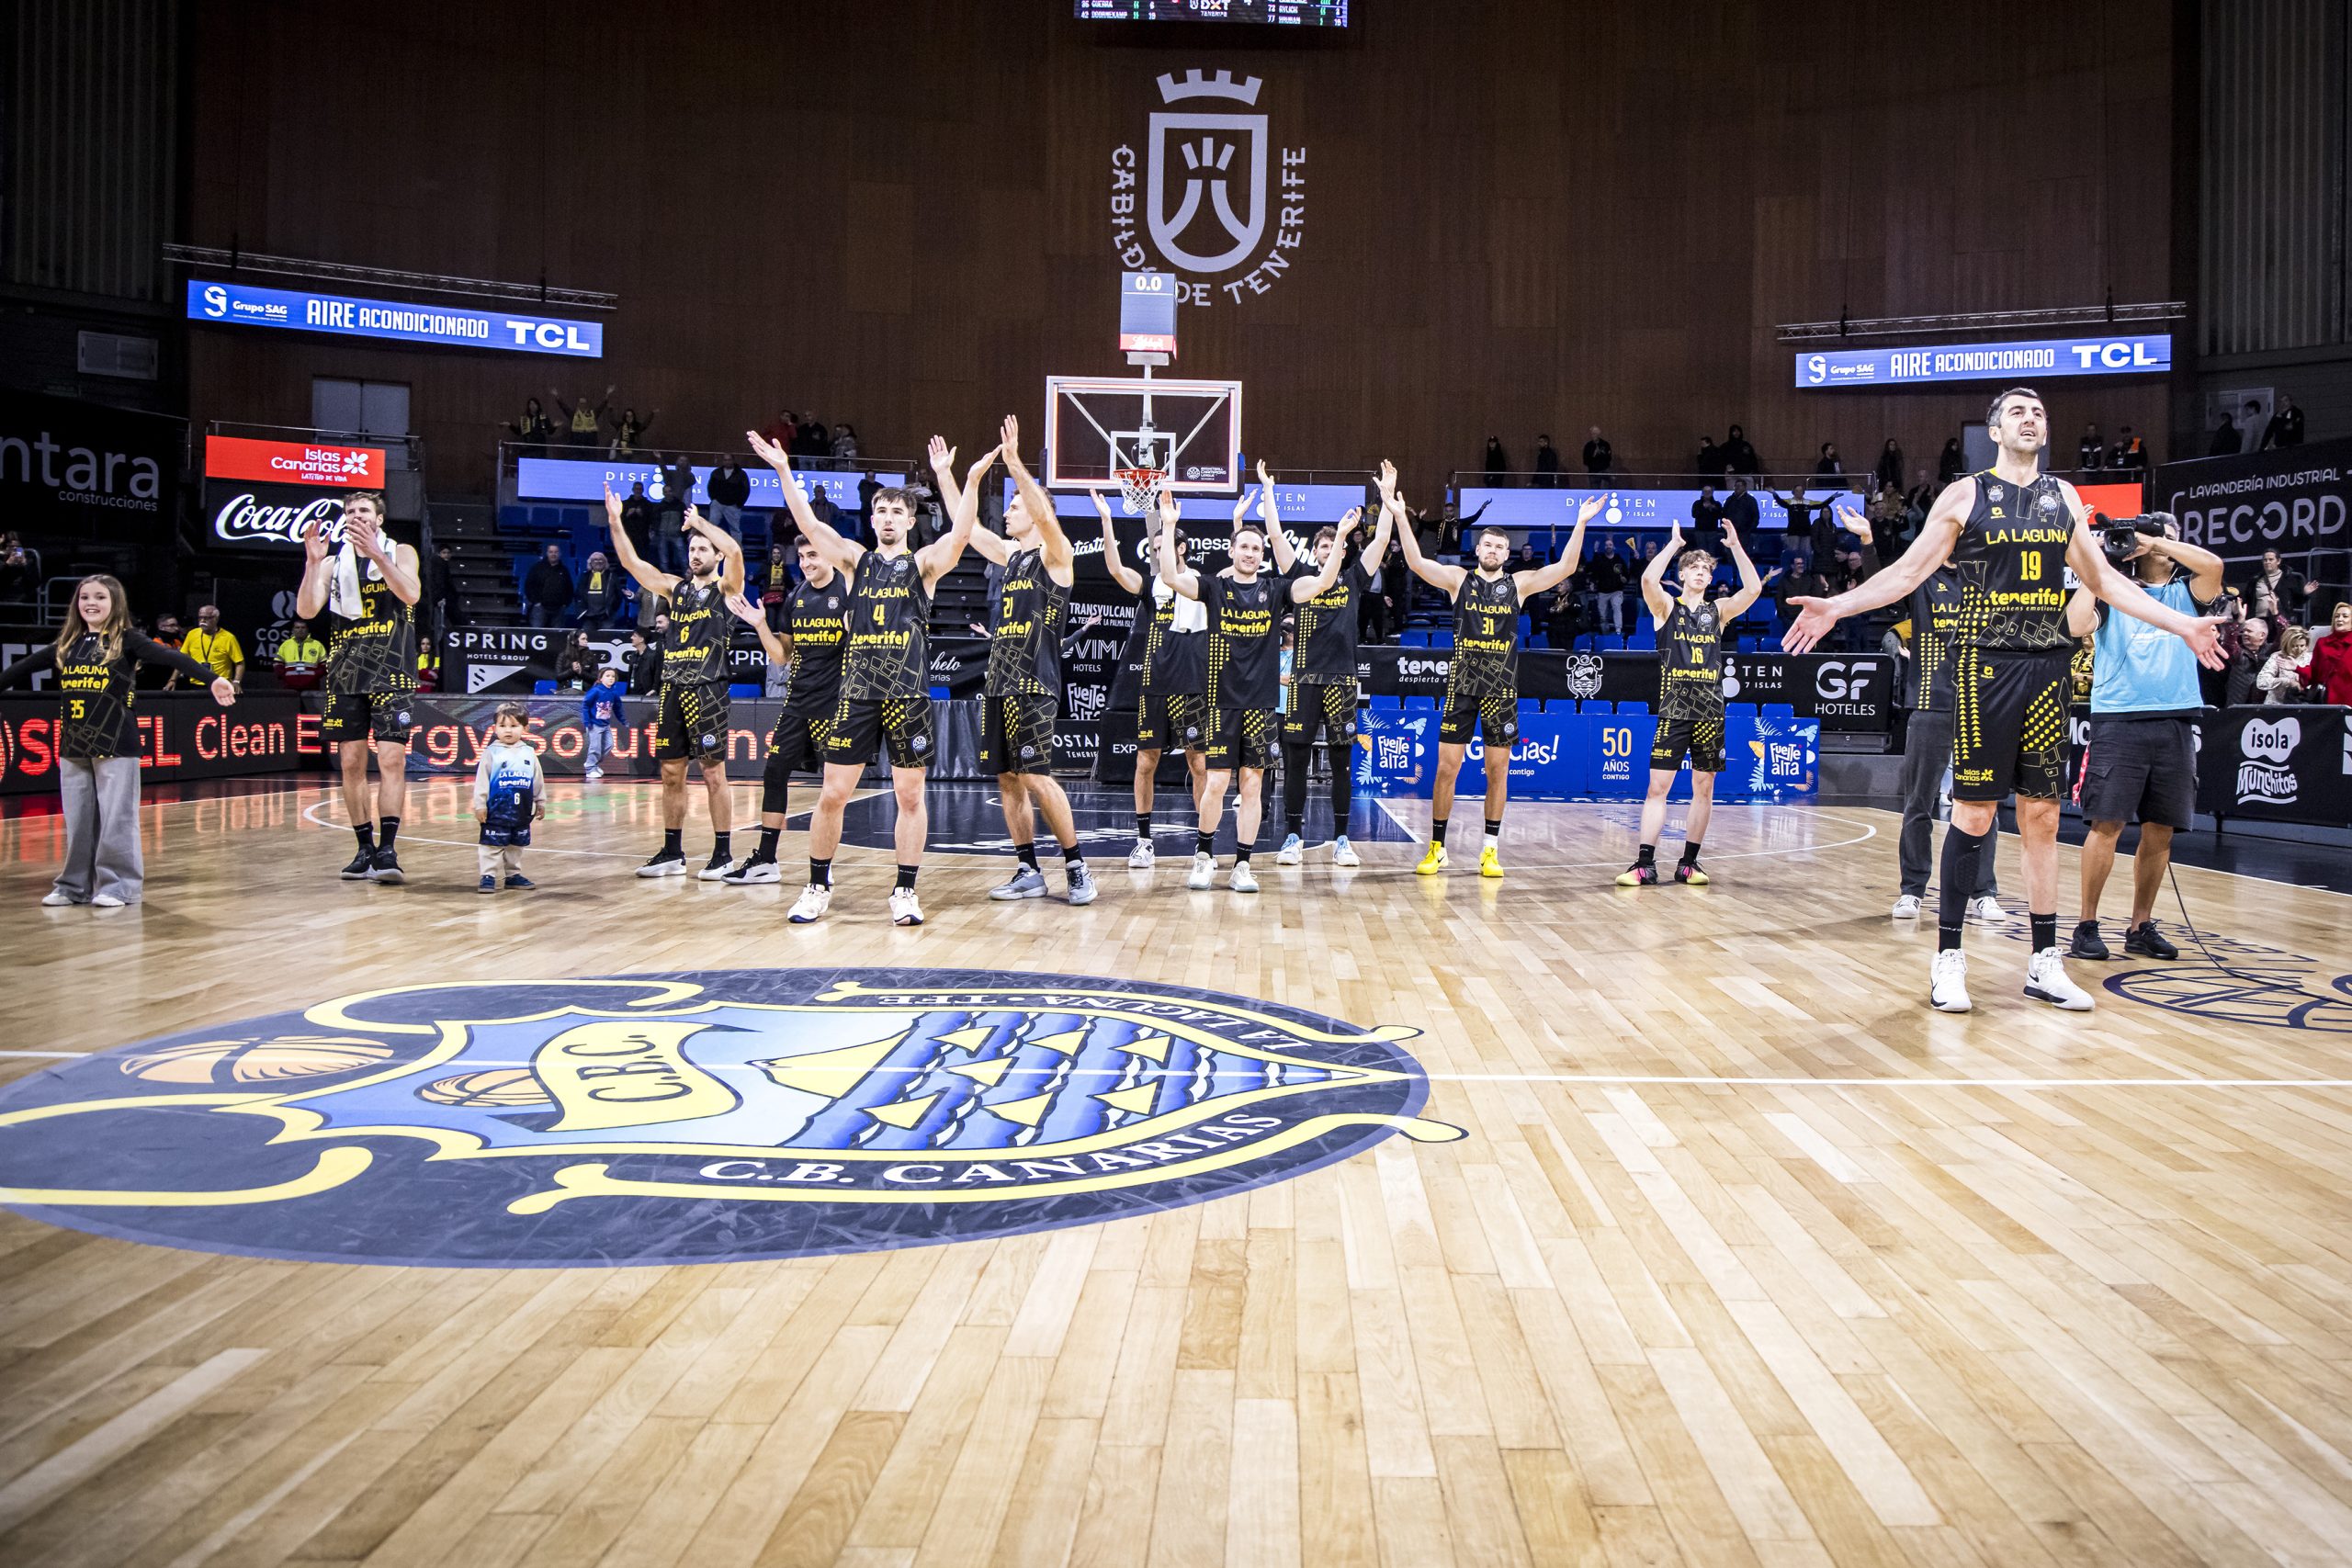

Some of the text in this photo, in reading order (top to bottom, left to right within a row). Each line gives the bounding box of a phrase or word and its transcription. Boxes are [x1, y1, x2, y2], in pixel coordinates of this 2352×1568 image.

[1111, 144, 1306, 306] CABILD DE TENERIFE
[1136, 275, 1161, 291] 0.0
[232, 299, 590, 350] Grupo SAG AIRE ACONDICIONADO TCL
[1830, 343, 2157, 378] Grupo SAG AIRE ACONDICIONADO TCL
[306, 448, 340, 462] Islas
[0, 431, 159, 499] ntara
[271, 457, 341, 473] Canarias
[2189, 468, 2340, 499] LAVANDERÍA INDUSTRIAL
[59, 491, 157, 512] construcciones
[1624, 499, 1656, 508] TEN
[1760, 499, 1779, 508] TE
[216, 493, 351, 544] Coca-Col
[2184, 495, 2346, 546] RECORD
[1985, 528, 2068, 545] LA LAGUNA
[2020, 550, 2041, 581] 19
[362, 582, 390, 594] AGUN
[858, 585, 910, 598] LA LAGUNA
[679, 608, 712, 623] LAGUNA
[873, 604, 885, 626] 4
[1220, 606, 1272, 620] LA LAGUNA
[1465, 601, 1511, 614] LA LAGUNA
[1932, 603, 1946, 613] LA
[792, 617, 842, 627] LA LAGUNA
[1481, 616, 1495, 635] 31
[448, 632, 548, 650] SPRING
[681, 625, 689, 643] 6
[1674, 631, 1685, 640] LA
[1690, 646, 1703, 663] 16
[69, 665, 109, 676] LAGUNA
[1398, 675, 1440, 683] despierta
[1742, 665, 1782, 677] TEN
[1816, 661, 1877, 700] GF
[1815, 704, 1876, 716] HOTELES
[196, 714, 285, 760] Clean
[297, 713, 496, 766] Ergy
[1601, 728, 1633, 757] 50
[2251, 727, 2289, 749] isola
[1509, 768, 1535, 776] contigo
[1601, 759, 1630, 773] AÑOS
[514, 793, 521, 805] 6
[878, 994, 1313, 1051] LA LAGUNA TFE
[561, 1034, 693, 1102] C.B.C.
[698, 1112, 1284, 1185] C.B. CANARIAS
